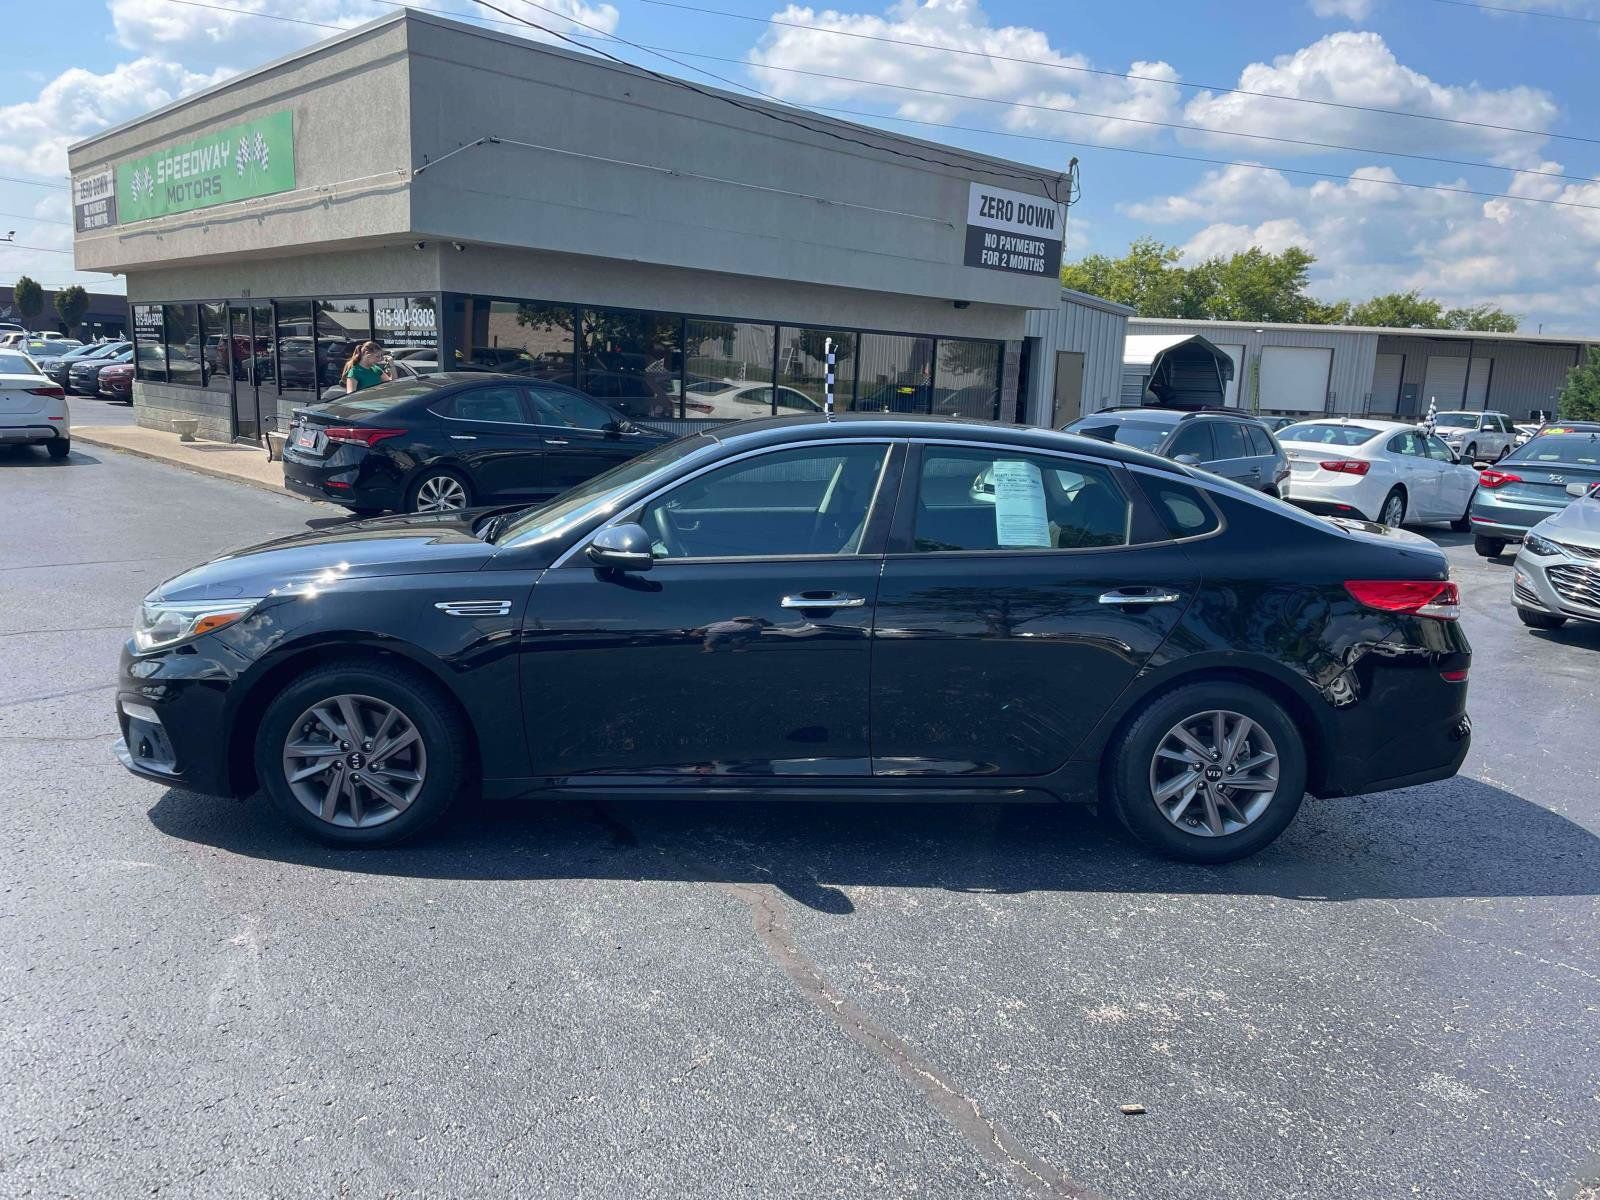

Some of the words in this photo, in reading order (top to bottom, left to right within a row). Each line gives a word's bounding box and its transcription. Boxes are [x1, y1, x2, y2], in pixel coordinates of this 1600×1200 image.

[157, 139, 230, 185] SPEEDWAY
[167, 175, 222, 205] MOTORS
[980, 195, 1013, 222] ZERO
[1017, 202, 1055, 230] DOWN
[984, 232, 998, 249] NO
[1000, 235, 1045, 257] PAYMENTS
[981, 249, 999, 267] FOR
[1001, 253, 1010, 268] 2
[1009, 253, 1045, 273] MONTHS
[375, 308, 435, 327] 615-904-9303
[352, 753, 361, 769] KIA
